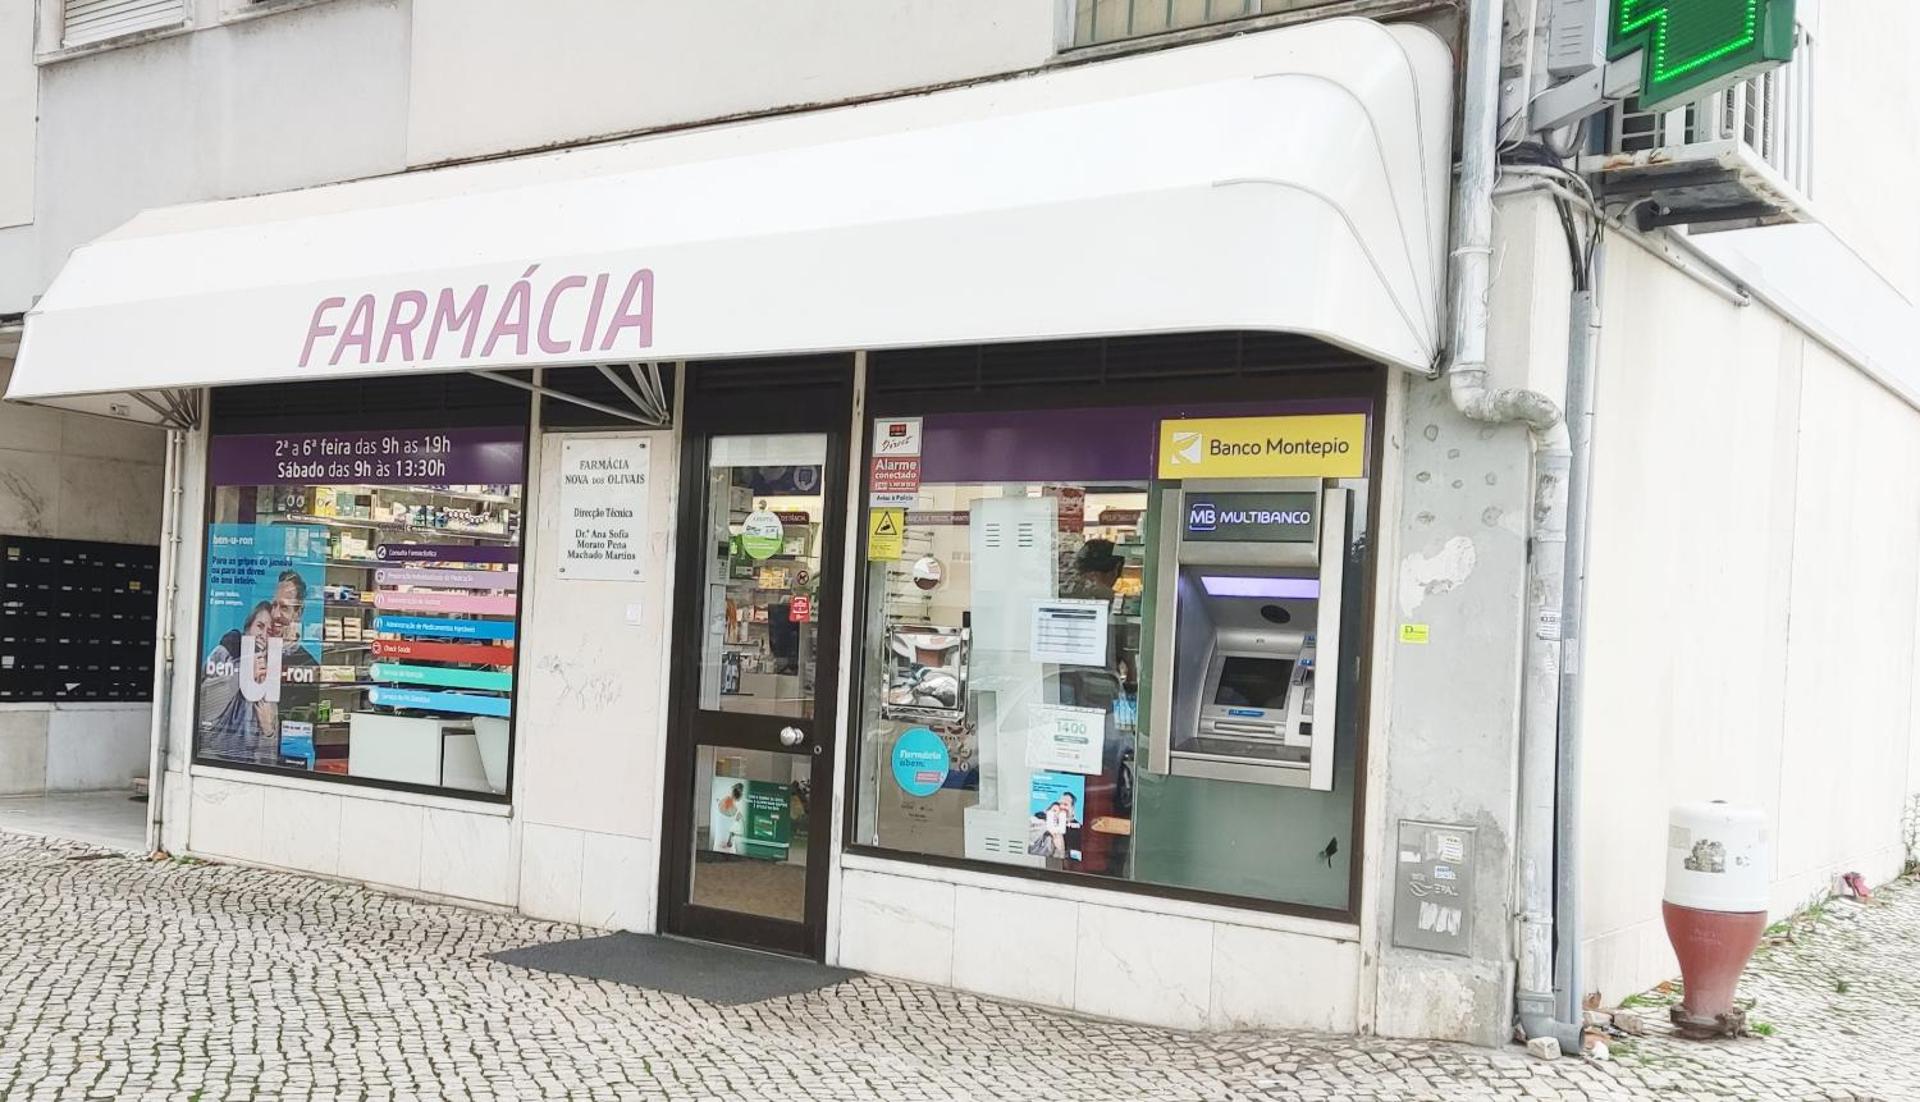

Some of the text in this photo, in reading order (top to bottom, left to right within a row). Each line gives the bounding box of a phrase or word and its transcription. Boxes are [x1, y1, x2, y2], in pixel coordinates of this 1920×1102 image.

[298, 263, 655, 368] FARMÁCIA
[275, 440, 289, 456] 2ª
[292, 443, 299, 456] a
[303, 439, 317, 456] 6ª
[321, 438, 350, 455] feira
[355, 438, 377, 454] das
[382, 437, 399, 454] 9h
[424, 436, 451, 453] 19h
[1210, 437, 1349, 458] Banco Montepio
[277, 459, 446, 478] Sábado das 9h às 13:30h
[579, 456, 630, 470] FARMÁCIA
[875, 458, 917, 471] Alarme
[565, 474, 589, 485] NOVA
[607, 473, 646, 485] OLIVAIS
[875, 471, 917, 480] conectado
[574, 507, 633, 520] Direcção Técnica
[1189, 510, 1311, 524] MB MULTIBANCO
[213, 534, 253, 545] ben-u-ron
[592, 529, 606, 539] Ana
[609, 529, 629, 539] Sofia
[607, 540, 627, 550] Pena
[388, 548, 407, 556] Consulta
[567, 549, 636, 560] Machado Martins
